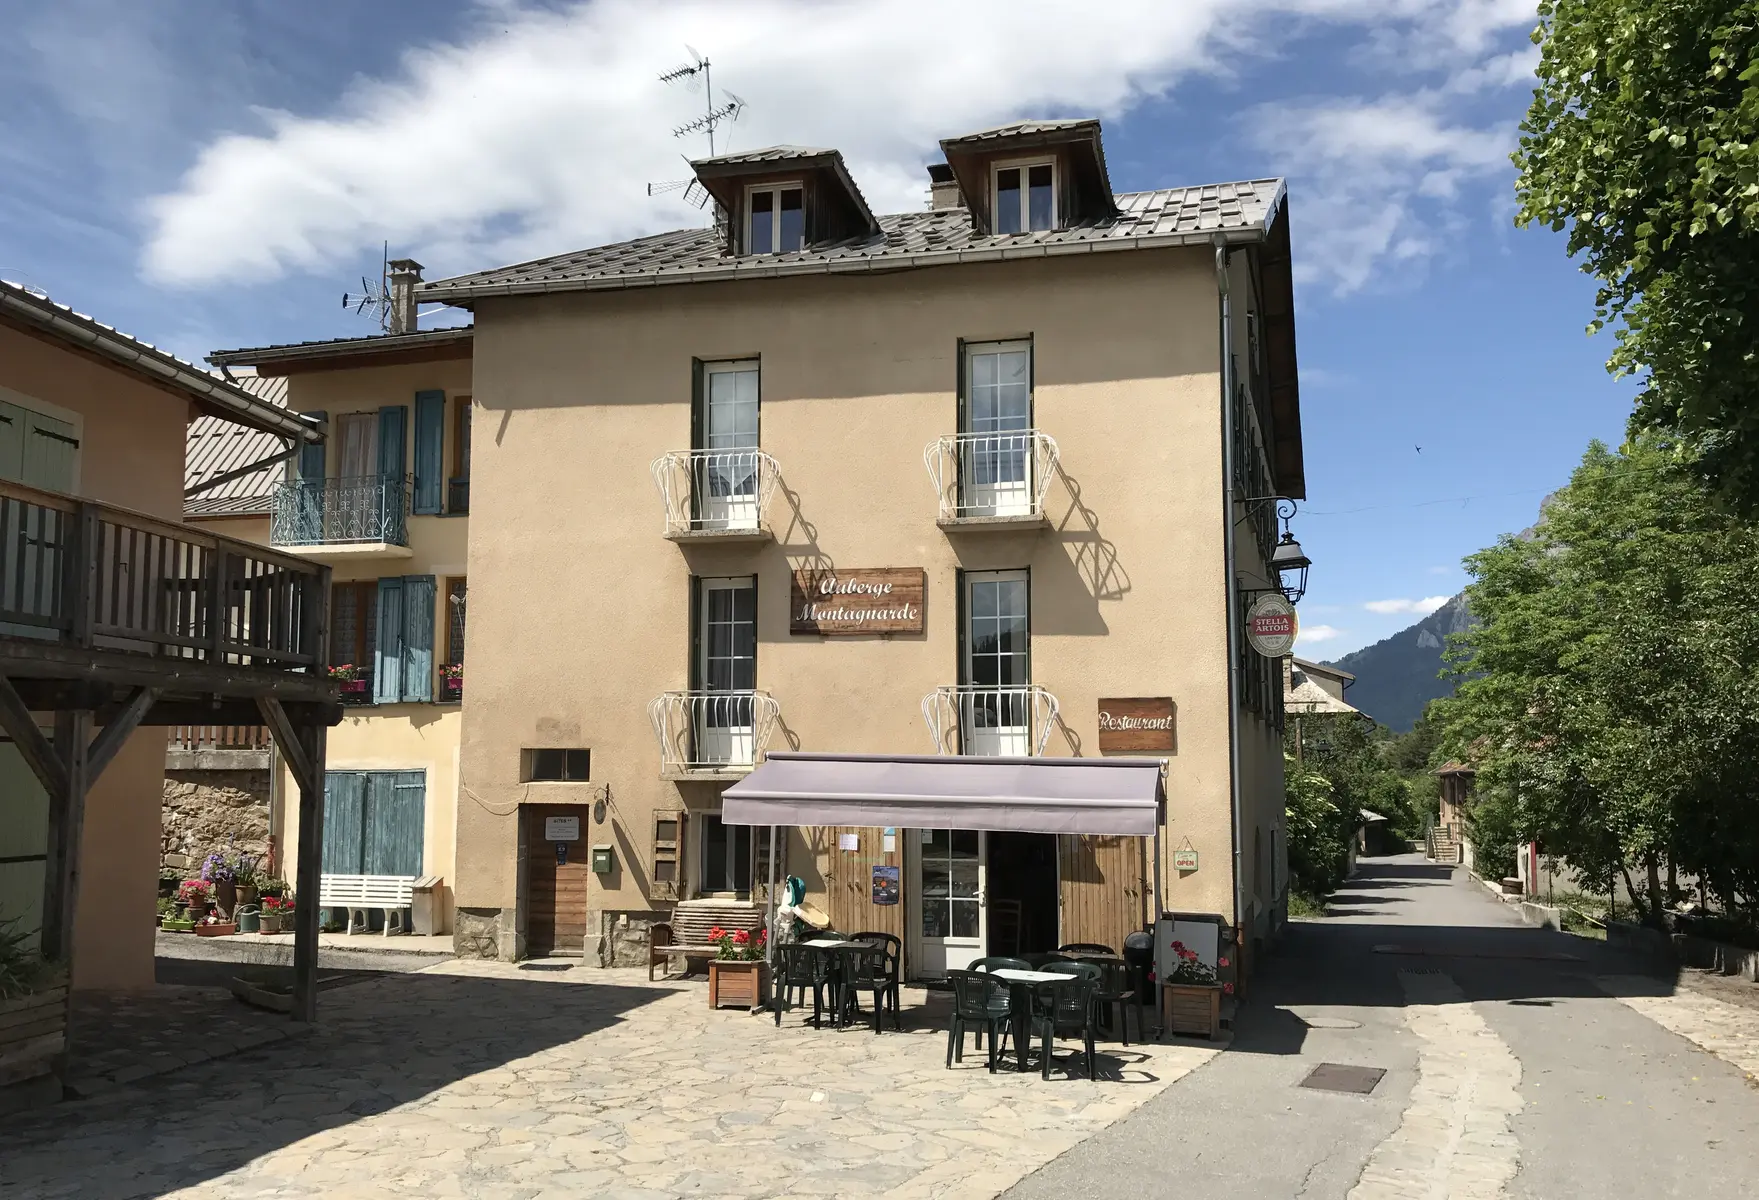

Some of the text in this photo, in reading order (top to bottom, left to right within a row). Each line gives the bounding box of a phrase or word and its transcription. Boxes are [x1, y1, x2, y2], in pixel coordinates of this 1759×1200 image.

[820, 577, 893, 599] Auberge
[796, 603, 918, 625] Montagnarde
[1255, 618, 1289, 626] STELLA
[1255, 624, 1289, 632] ARTOIS
[1098, 711, 1173, 730] Restaurant
